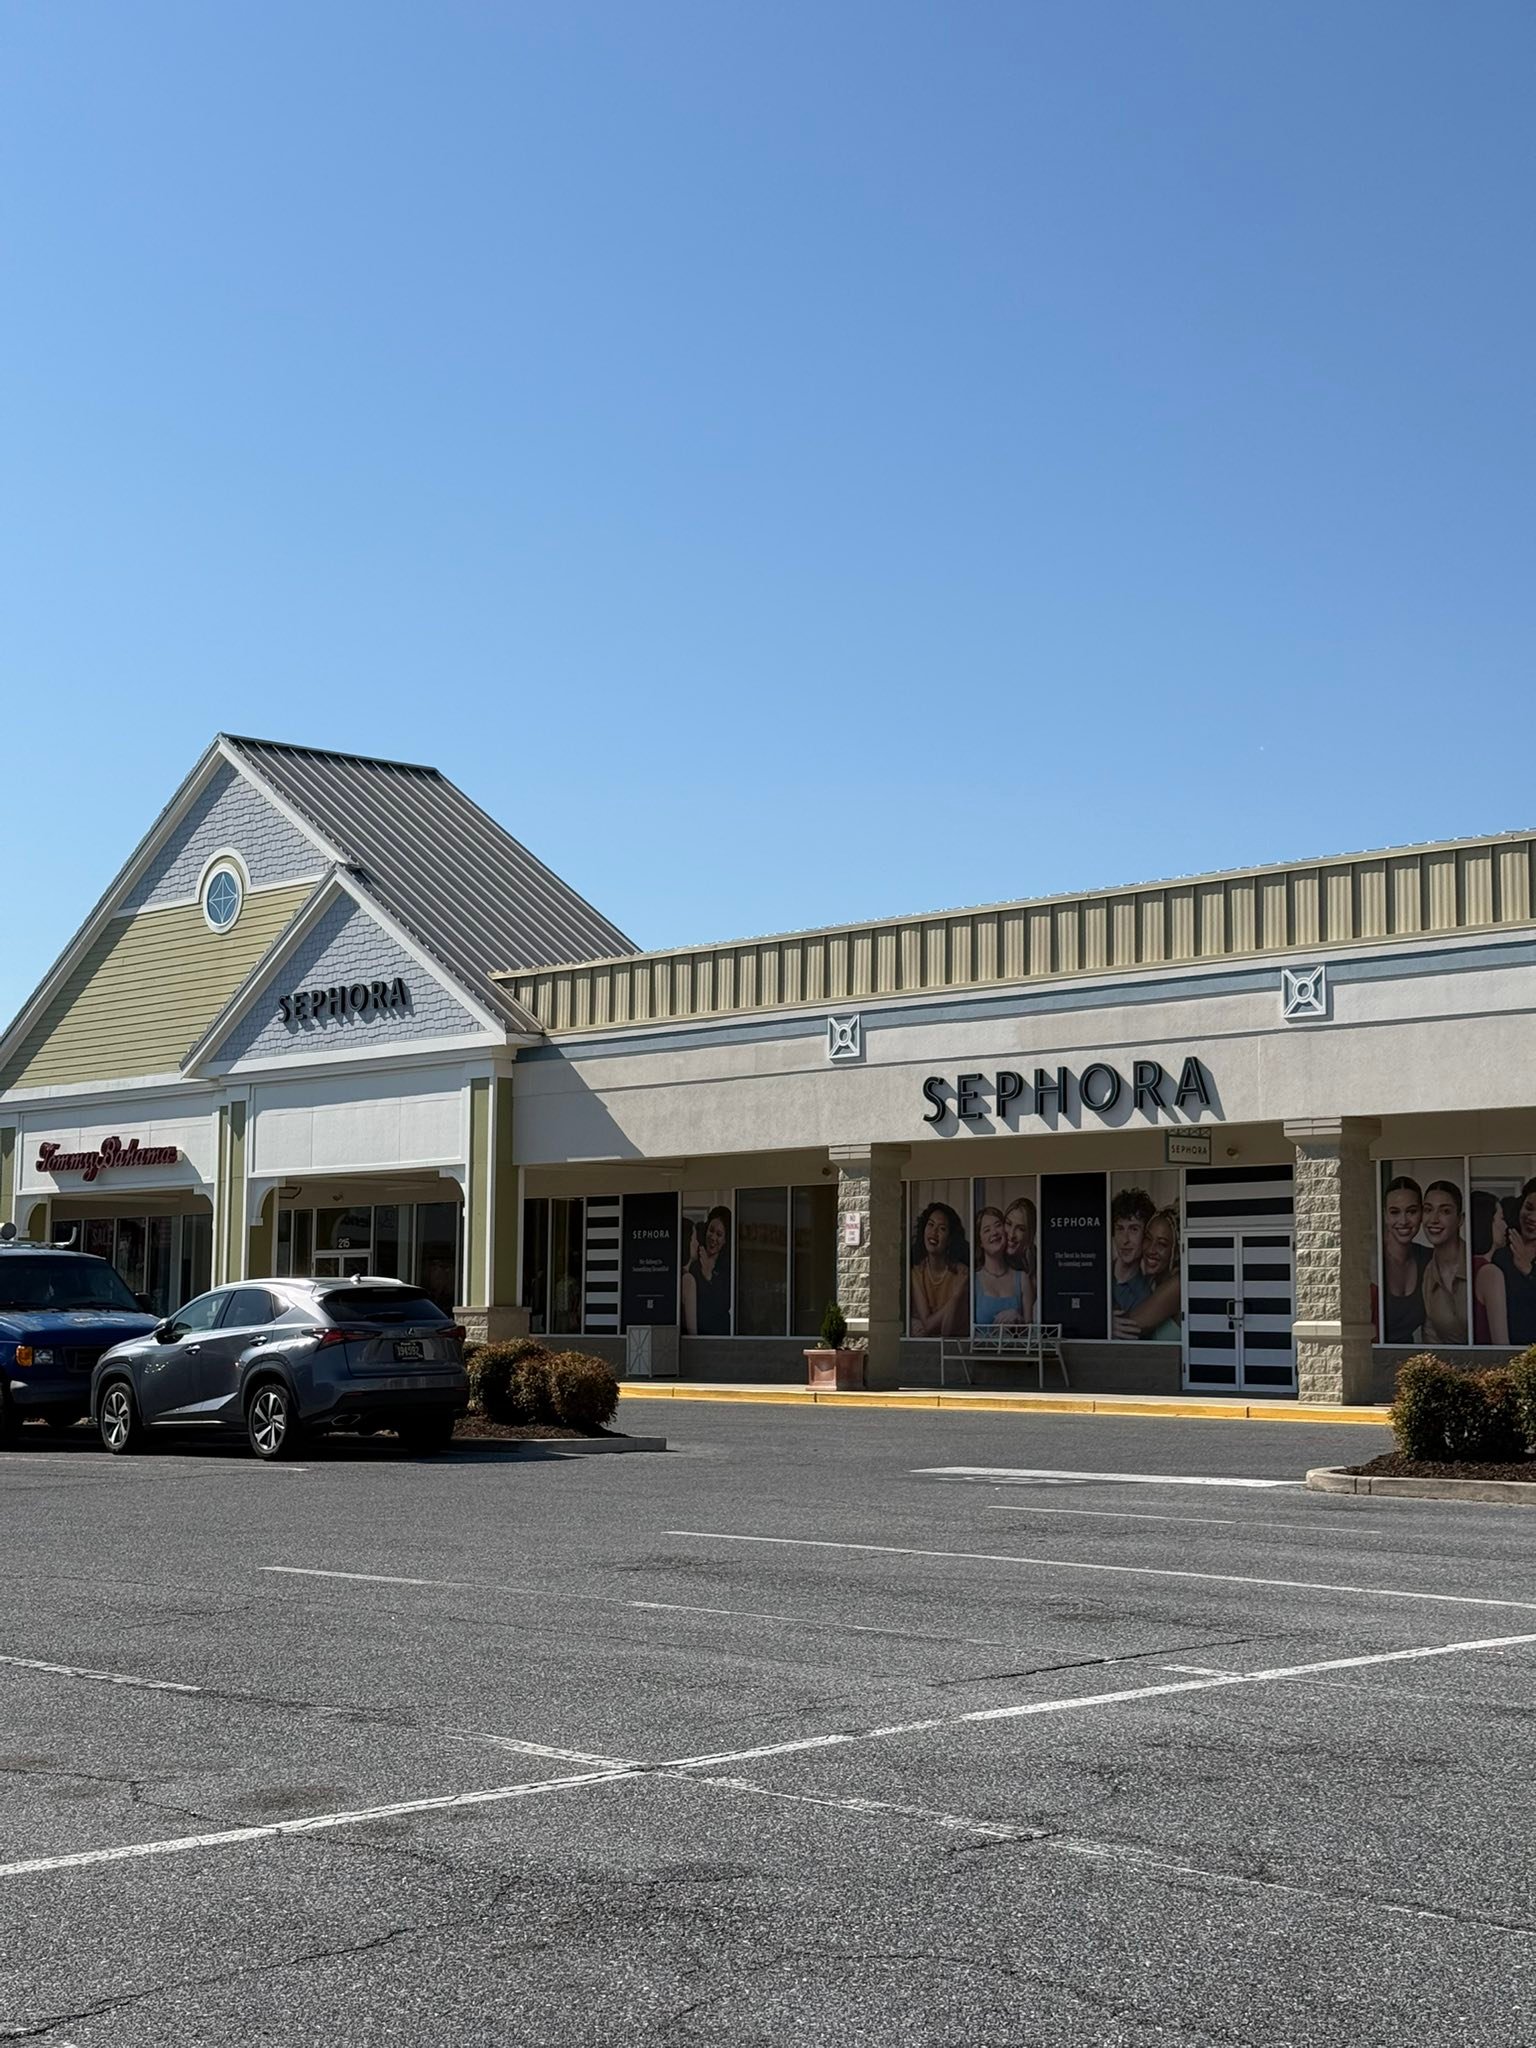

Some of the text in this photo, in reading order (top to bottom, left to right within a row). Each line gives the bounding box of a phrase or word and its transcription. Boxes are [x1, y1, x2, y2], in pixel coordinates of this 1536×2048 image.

[277, 977, 407, 1023] SEPHORA
[922, 1056, 1211, 1124] SEPHORA
[35, 1136, 178, 1182] Tommy Bahama
[1171, 1144, 1208, 1154] SEPHORA
[632, 1229, 670, 1240] SEPHORA
[1050, 1216, 1101, 1228] SEPHORA
